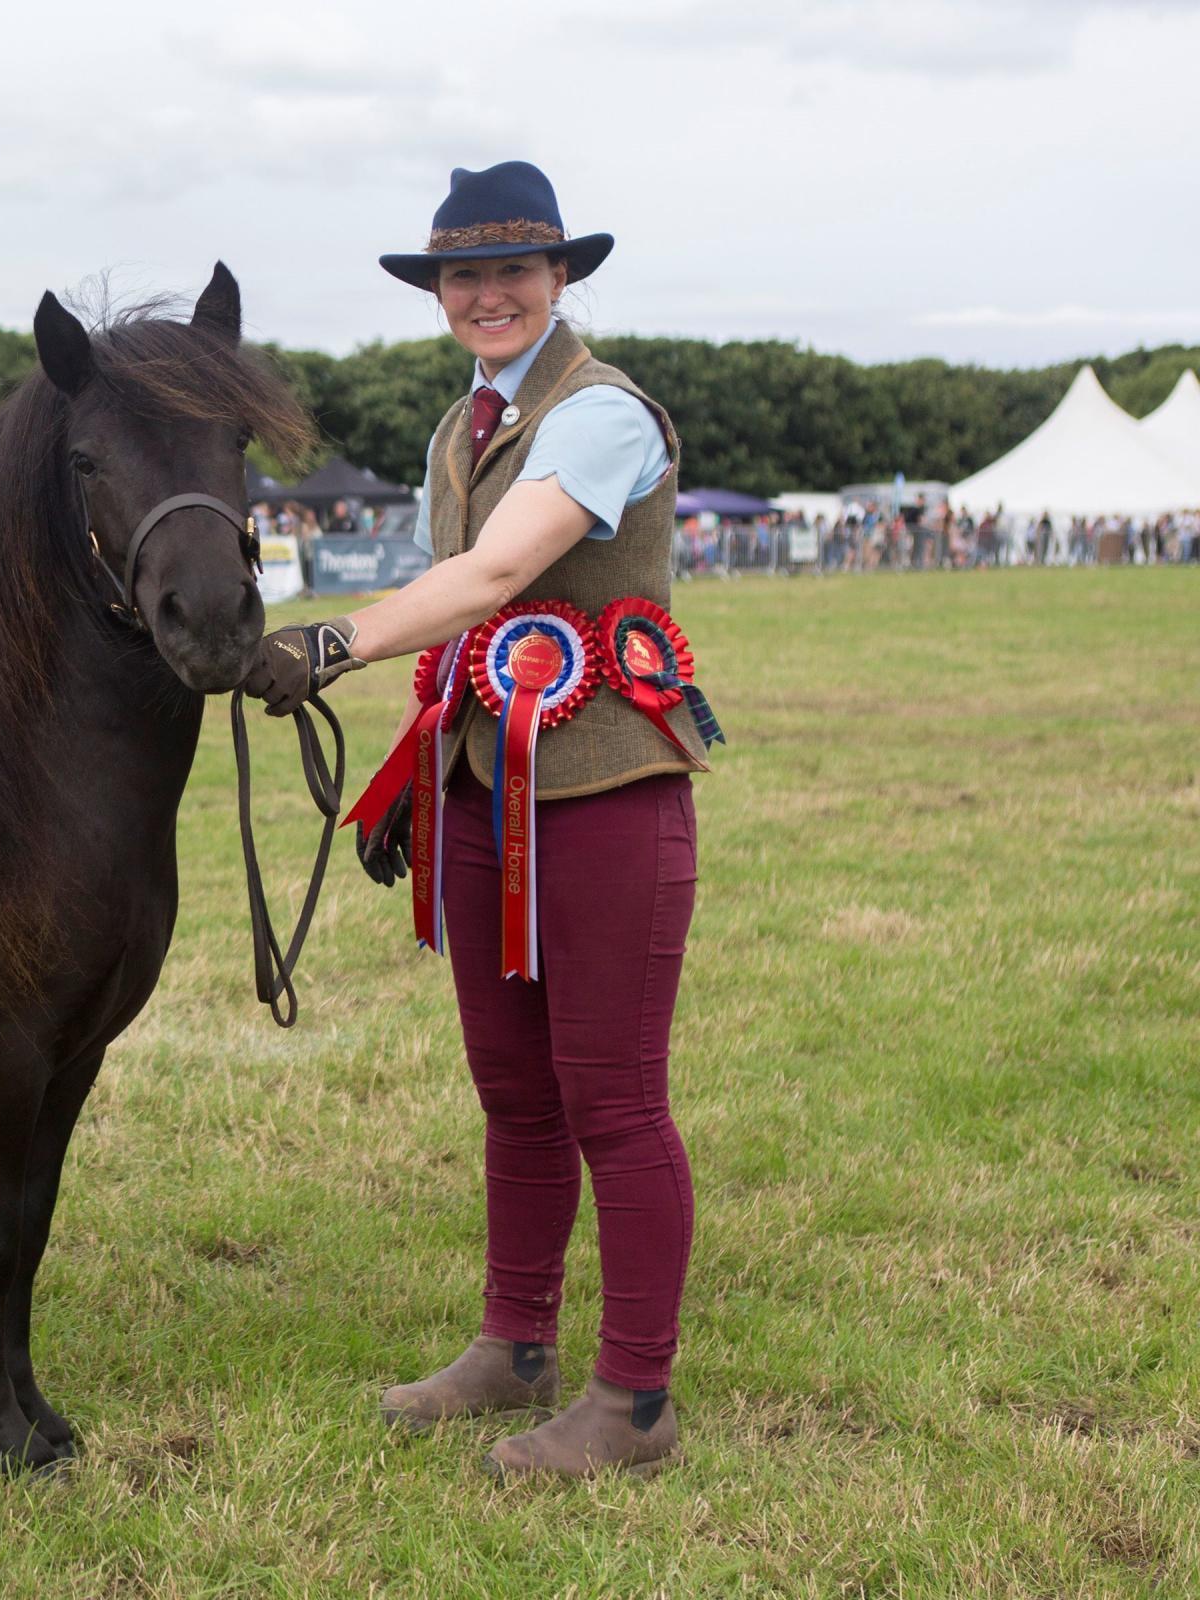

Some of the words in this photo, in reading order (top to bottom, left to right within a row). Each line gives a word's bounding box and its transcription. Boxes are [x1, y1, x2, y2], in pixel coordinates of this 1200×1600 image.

[418, 729, 432, 787] Overall
[416, 790, 432, 863] Shetland
[508, 775, 526, 836] Overall
[415, 865, 431, 904] Pony
[508, 842, 524, 894] Horse
